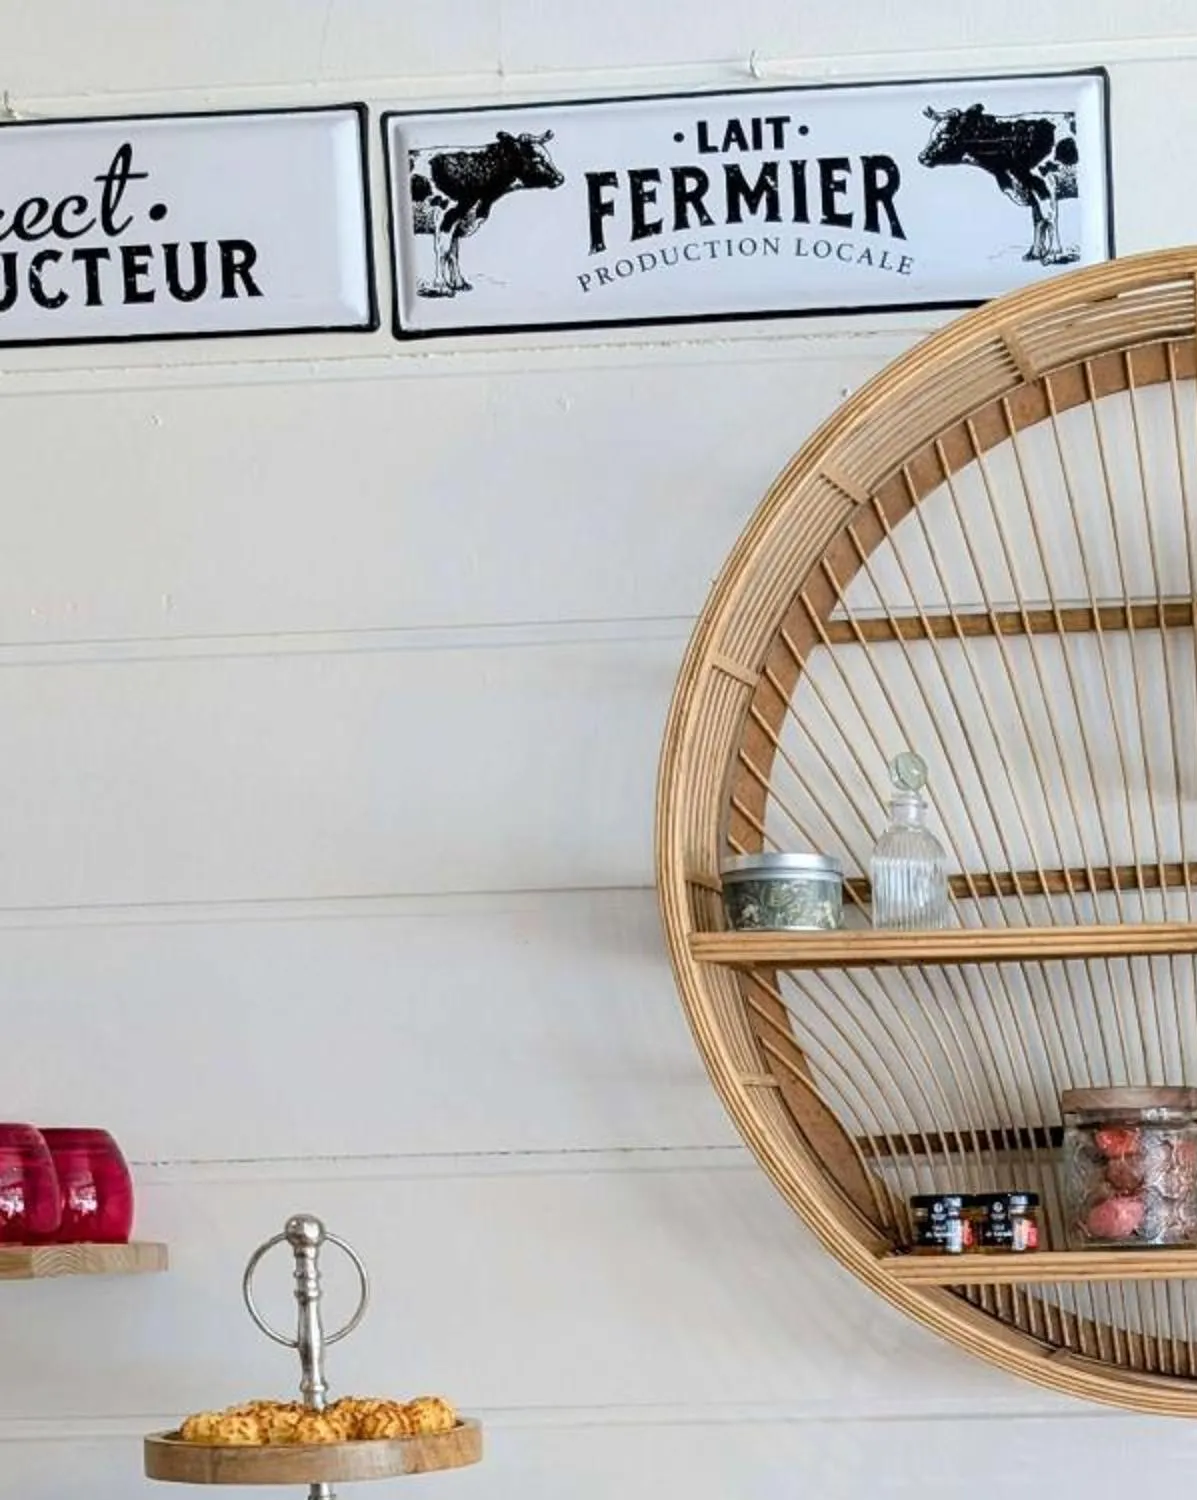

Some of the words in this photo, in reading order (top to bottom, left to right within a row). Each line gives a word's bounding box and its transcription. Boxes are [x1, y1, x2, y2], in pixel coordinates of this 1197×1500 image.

[697, 116, 790, 153] LAIT
[0, 143, 148, 242] ect
[584, 154, 907, 256] FERMIER
[577, 237, 781, 293] PRODUCTION
[795, 237, 914, 276] LOCALE
